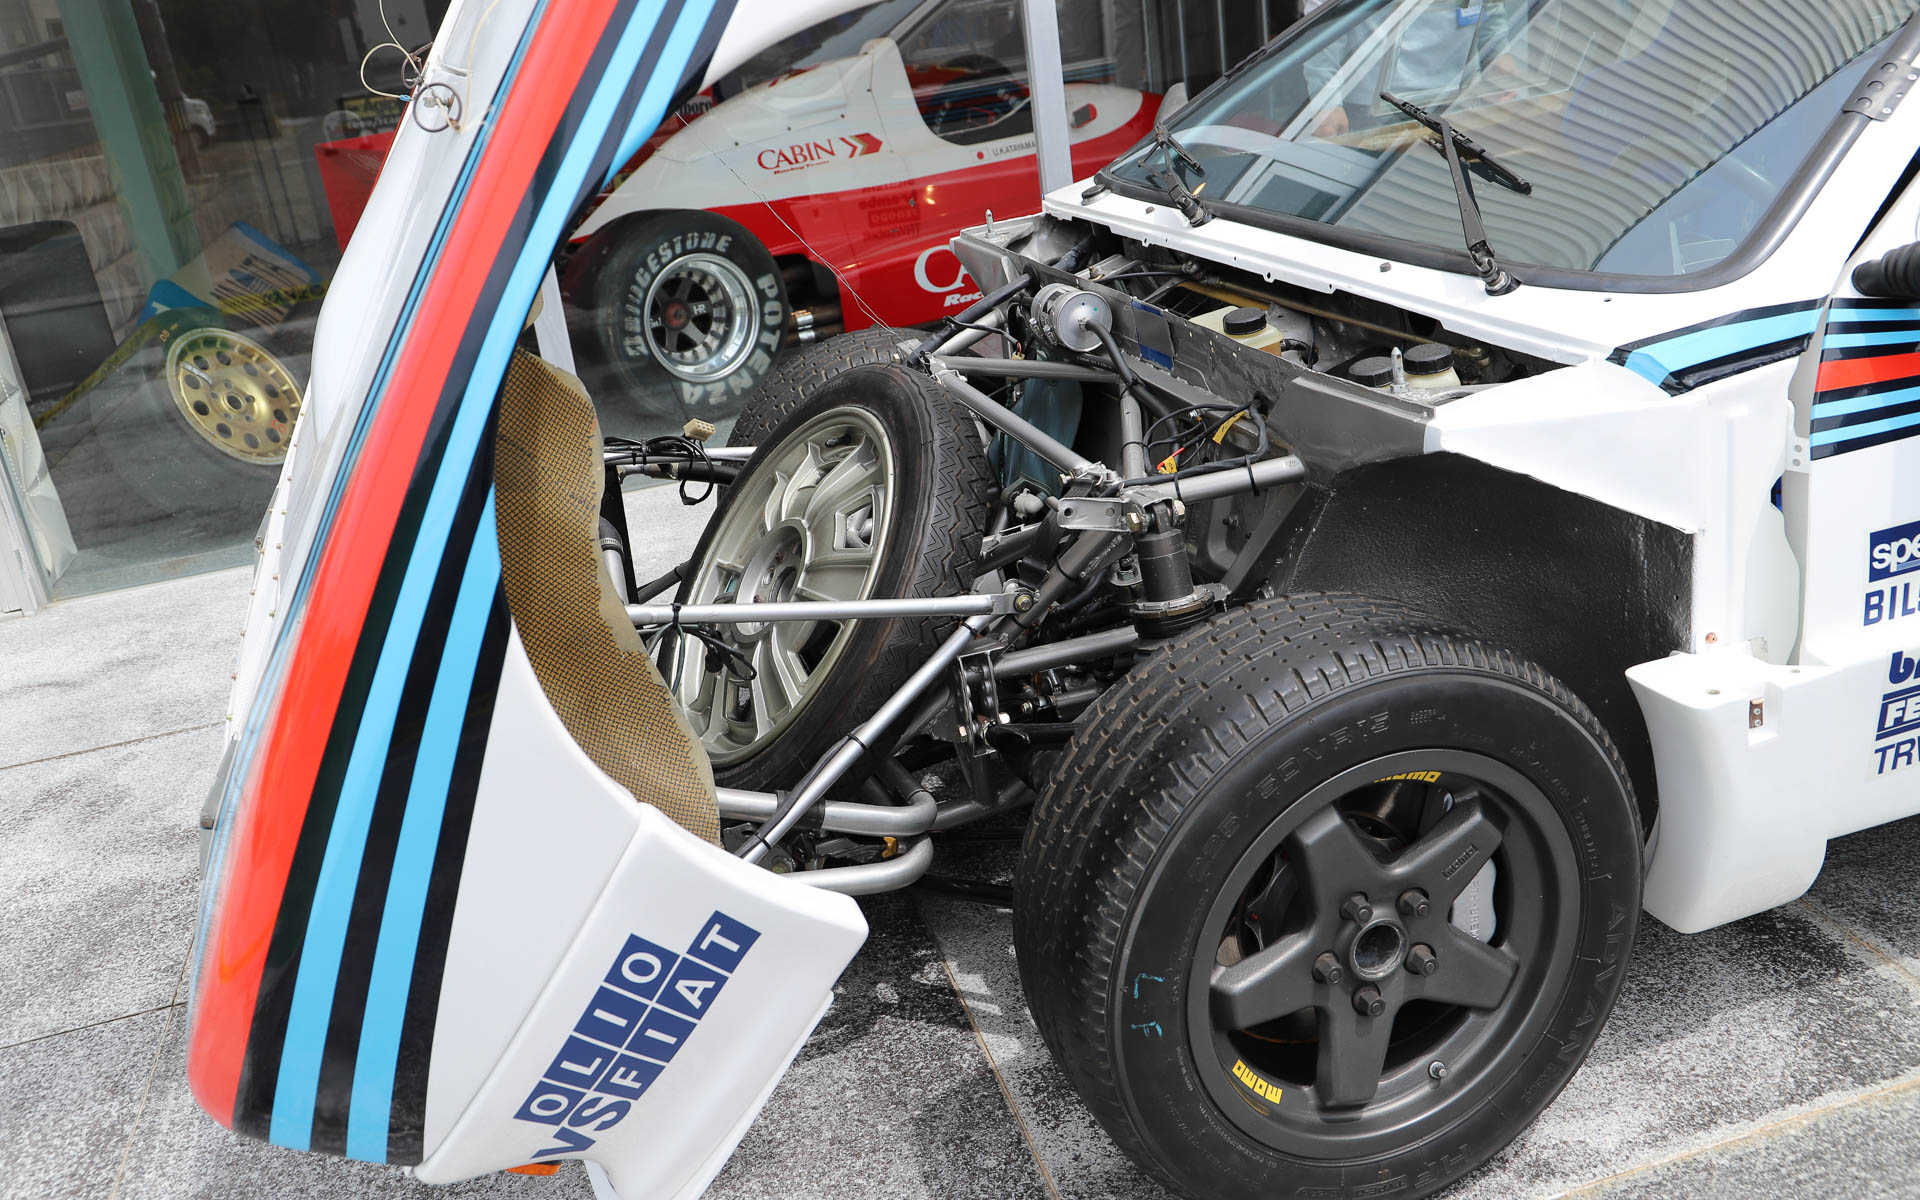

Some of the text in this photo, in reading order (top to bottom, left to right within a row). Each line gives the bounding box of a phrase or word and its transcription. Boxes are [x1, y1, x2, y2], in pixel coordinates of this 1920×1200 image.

[757, 138, 836, 170] CABIN
[679, 273, 783, 405] POTENZA
[529, 950, 663, 1117] OLIO
